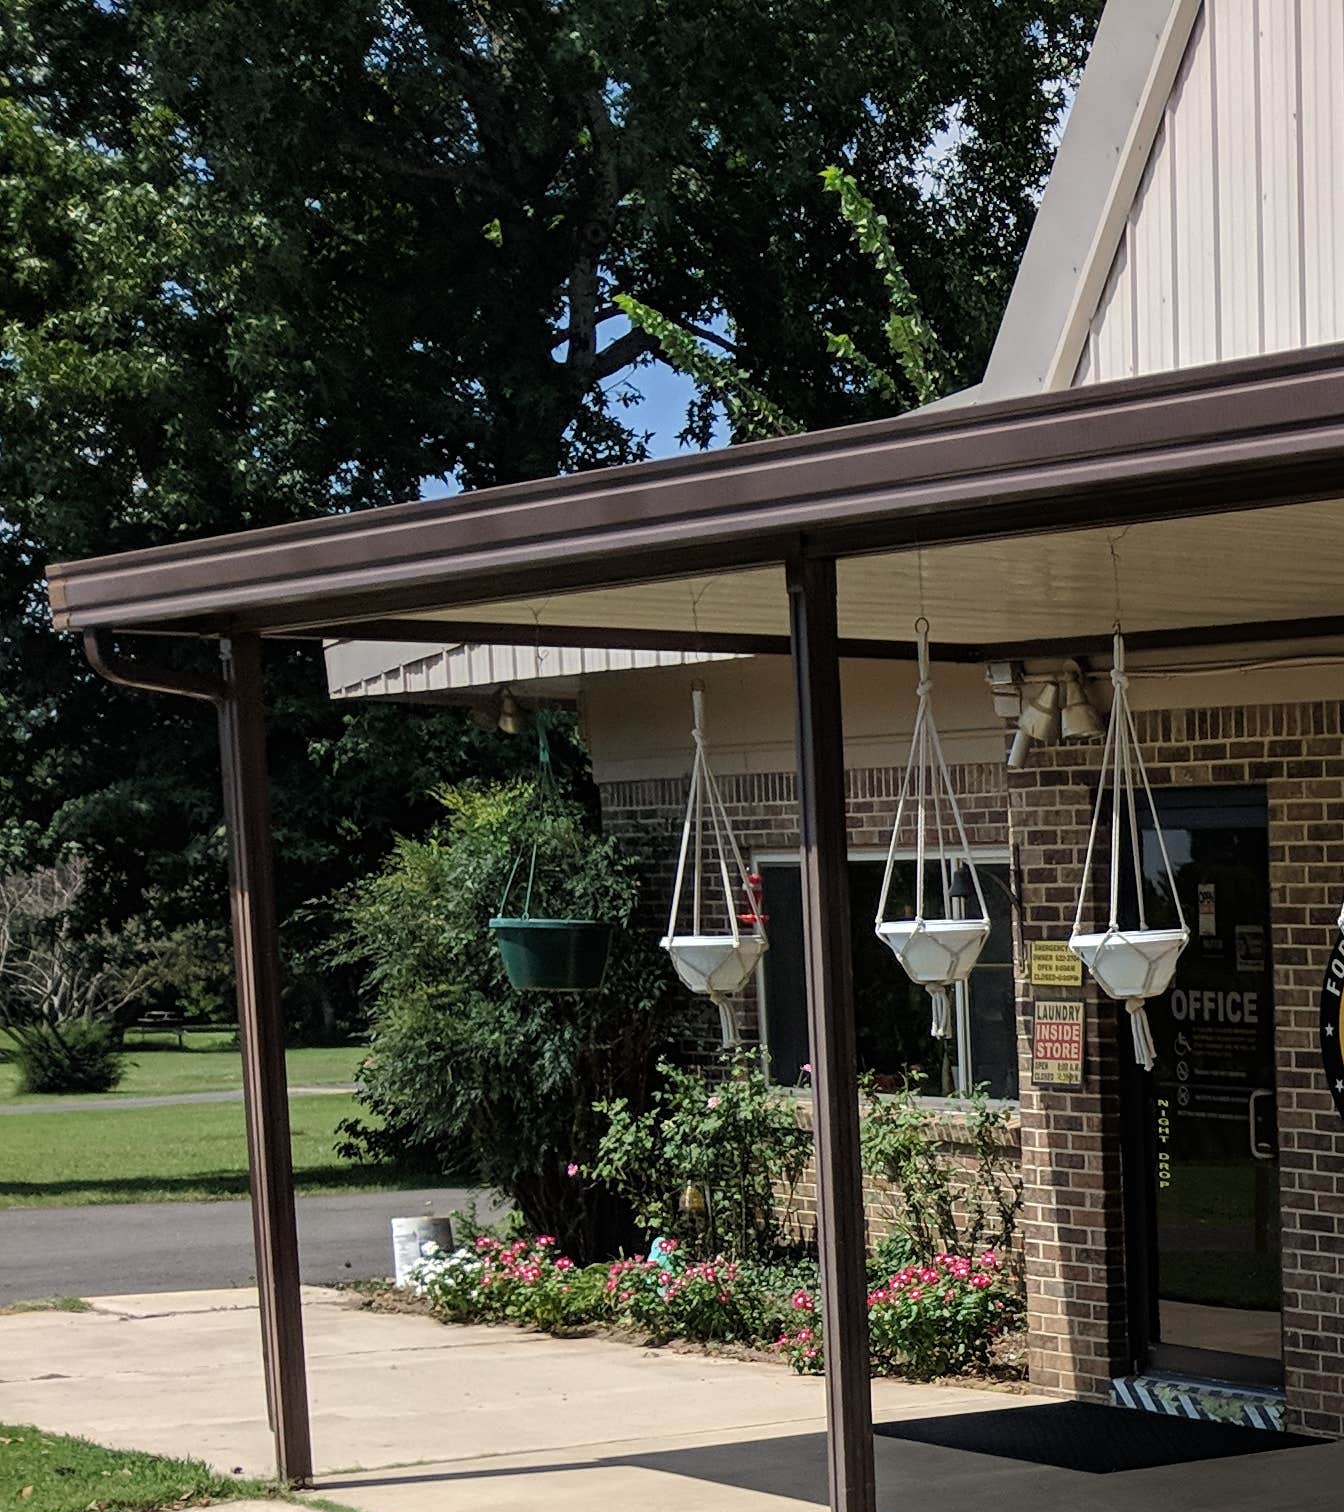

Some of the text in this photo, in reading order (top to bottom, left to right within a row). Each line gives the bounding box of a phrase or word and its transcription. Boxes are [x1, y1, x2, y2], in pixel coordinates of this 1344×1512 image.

[1037, 1004, 1081, 1022] LAUNDRY
[1170, 989, 1259, 1023] OFFICE
[1036, 1024, 1081, 1041] INSIDE
[1037, 1042, 1079, 1059] STORE
[1035, 1062, 1049, 1071] OPEN
[1035, 1072, 1054, 1081] CLOSED
[1157, 1098, 1171, 1188] NIGHT DROP
